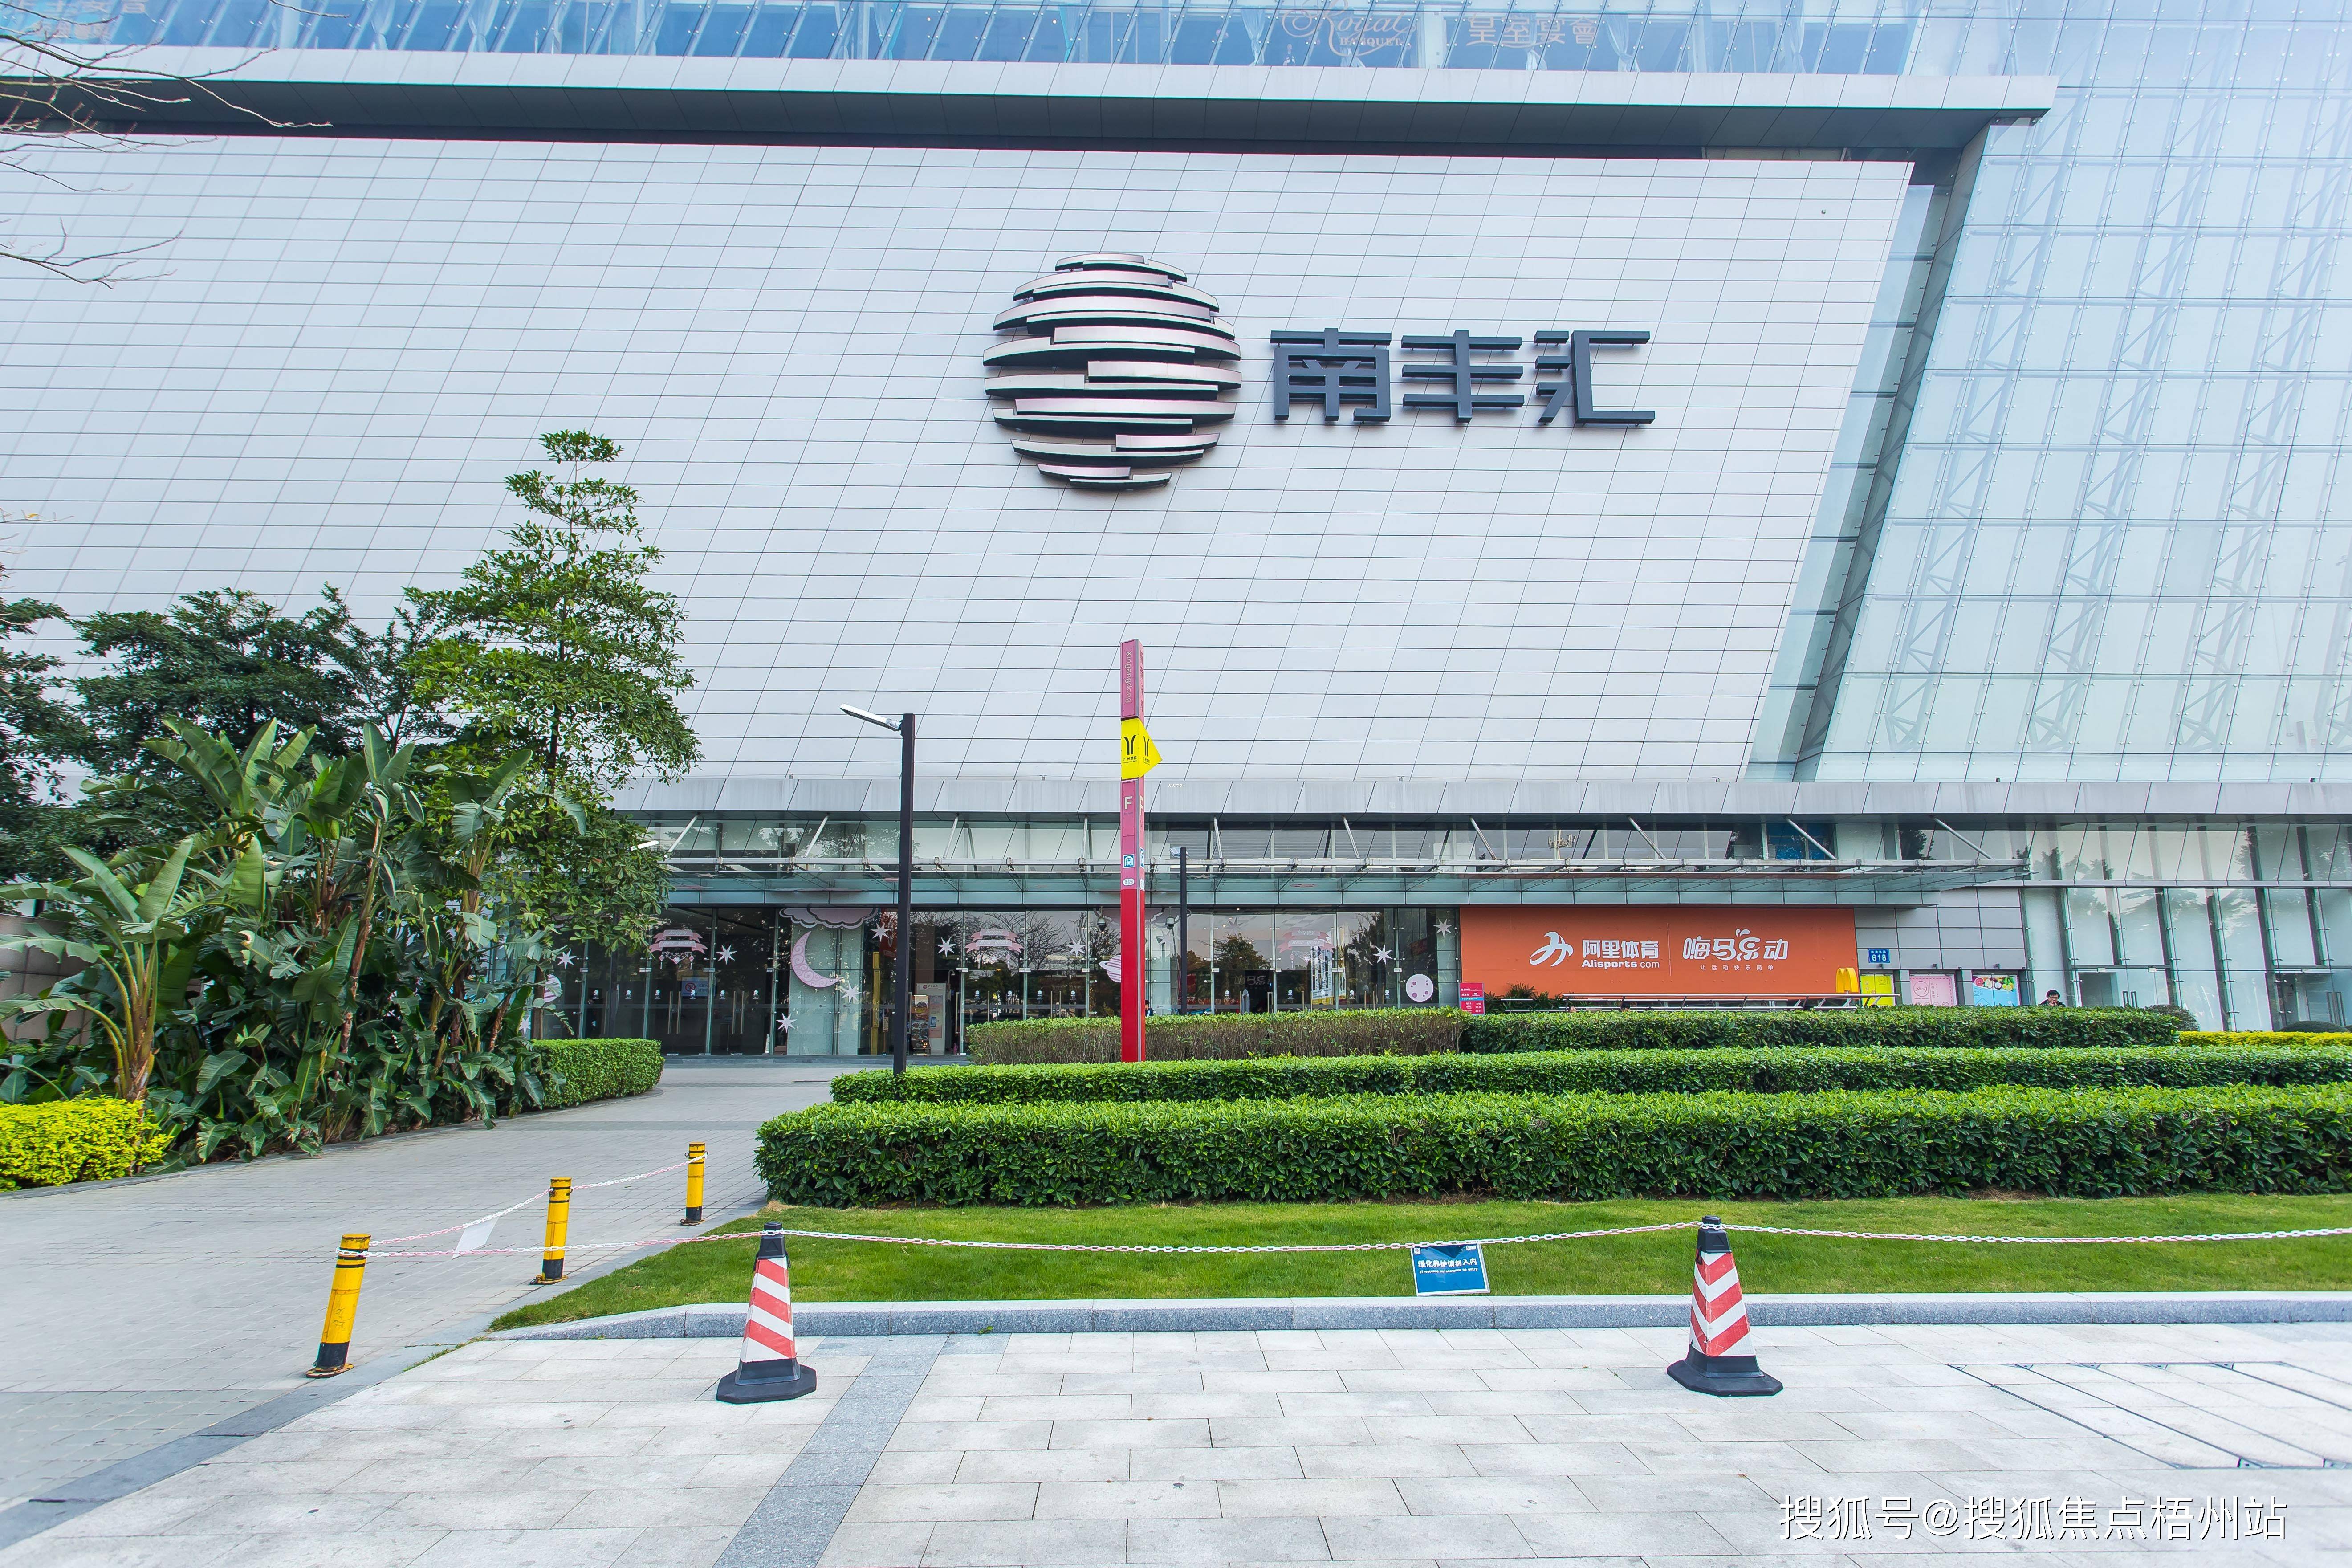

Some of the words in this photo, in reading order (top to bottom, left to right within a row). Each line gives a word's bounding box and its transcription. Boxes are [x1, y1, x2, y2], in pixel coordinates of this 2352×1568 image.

[1270, 328, 1656, 425] 南丰汇
[1124, 796, 1133, 810] F
[1582, 940, 1659, 959] 阿里体育
[1581, 959, 1637, 969] Alisports
[1418, 1258, 1477, 1268] 绿化养护请勿入内
